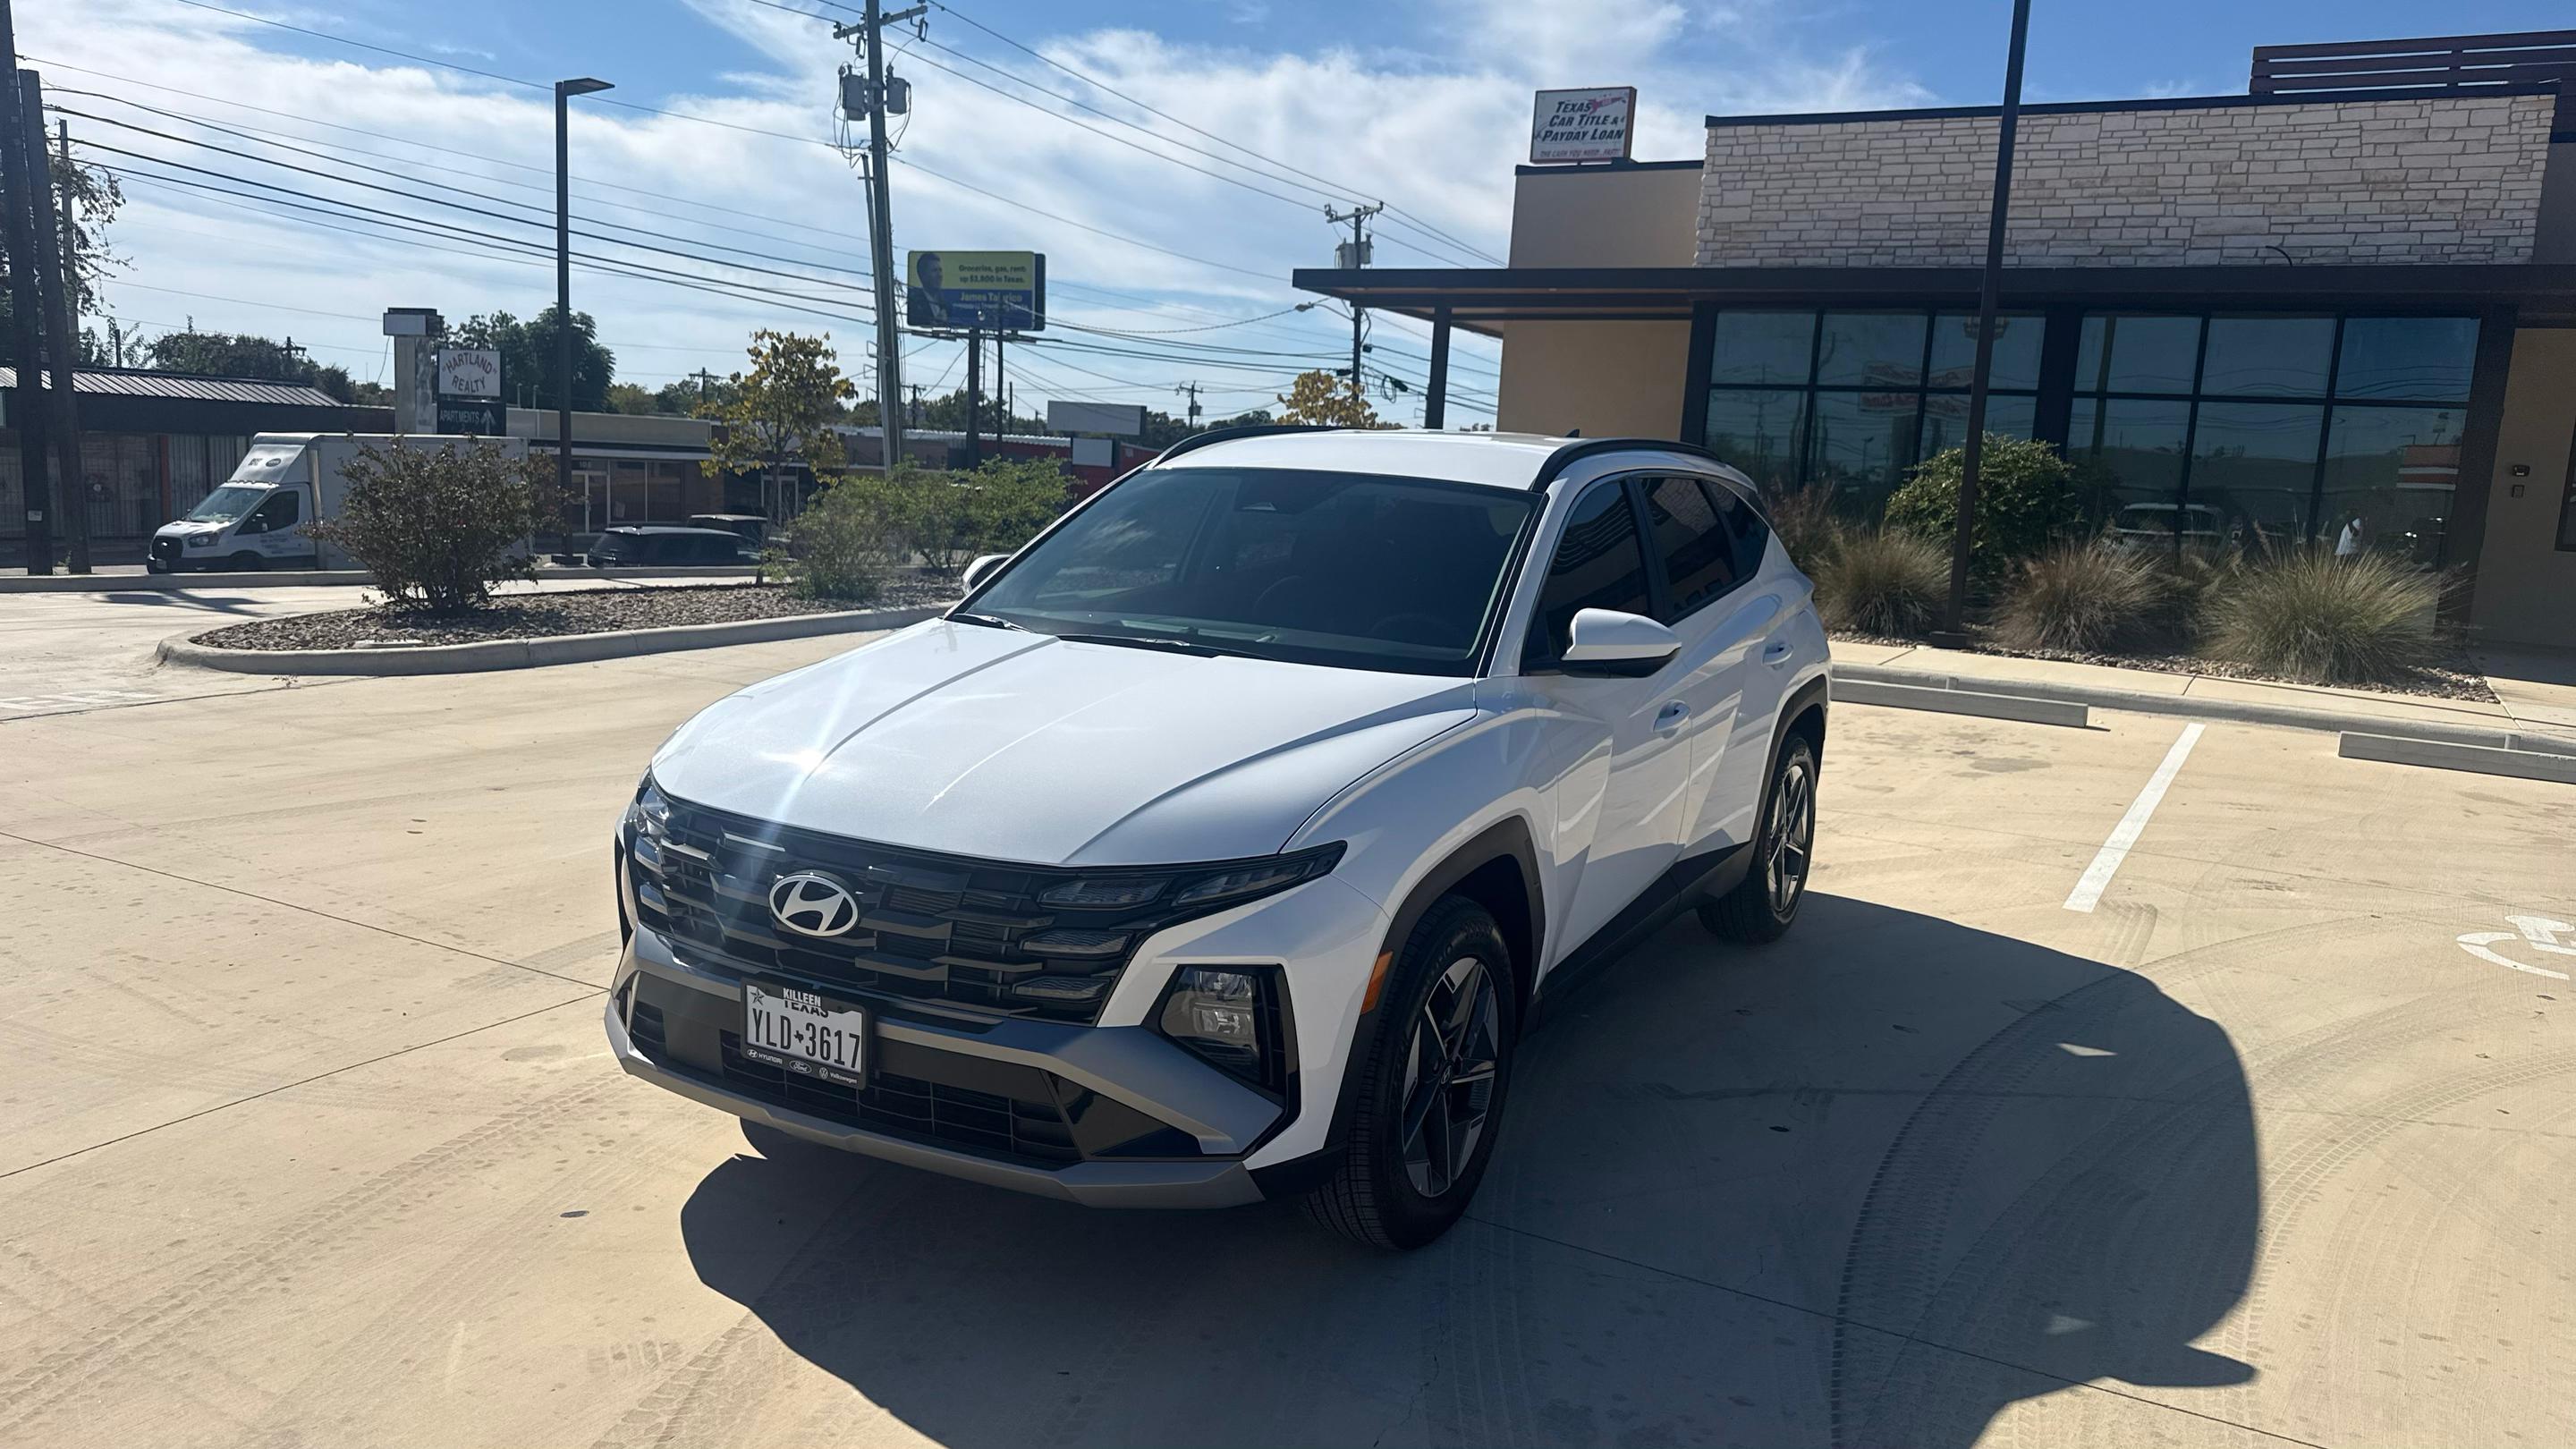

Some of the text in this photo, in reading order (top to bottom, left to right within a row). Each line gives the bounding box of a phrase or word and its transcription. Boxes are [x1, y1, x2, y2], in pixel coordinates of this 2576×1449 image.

[1555, 101, 1590, 113] TEXAS
[1549, 114, 1574, 128] CAR
[1578, 114, 1609, 126] TITLE
[1541, 128, 1624, 142] PAYDAY LOAN
[452, 375, 486, 394] REALTY
[439, 410, 480, 423] APARTMENTS
[783, 987, 821, 1007] KILLEEN
[758, 1052, 783, 1064] HYUNDAI
